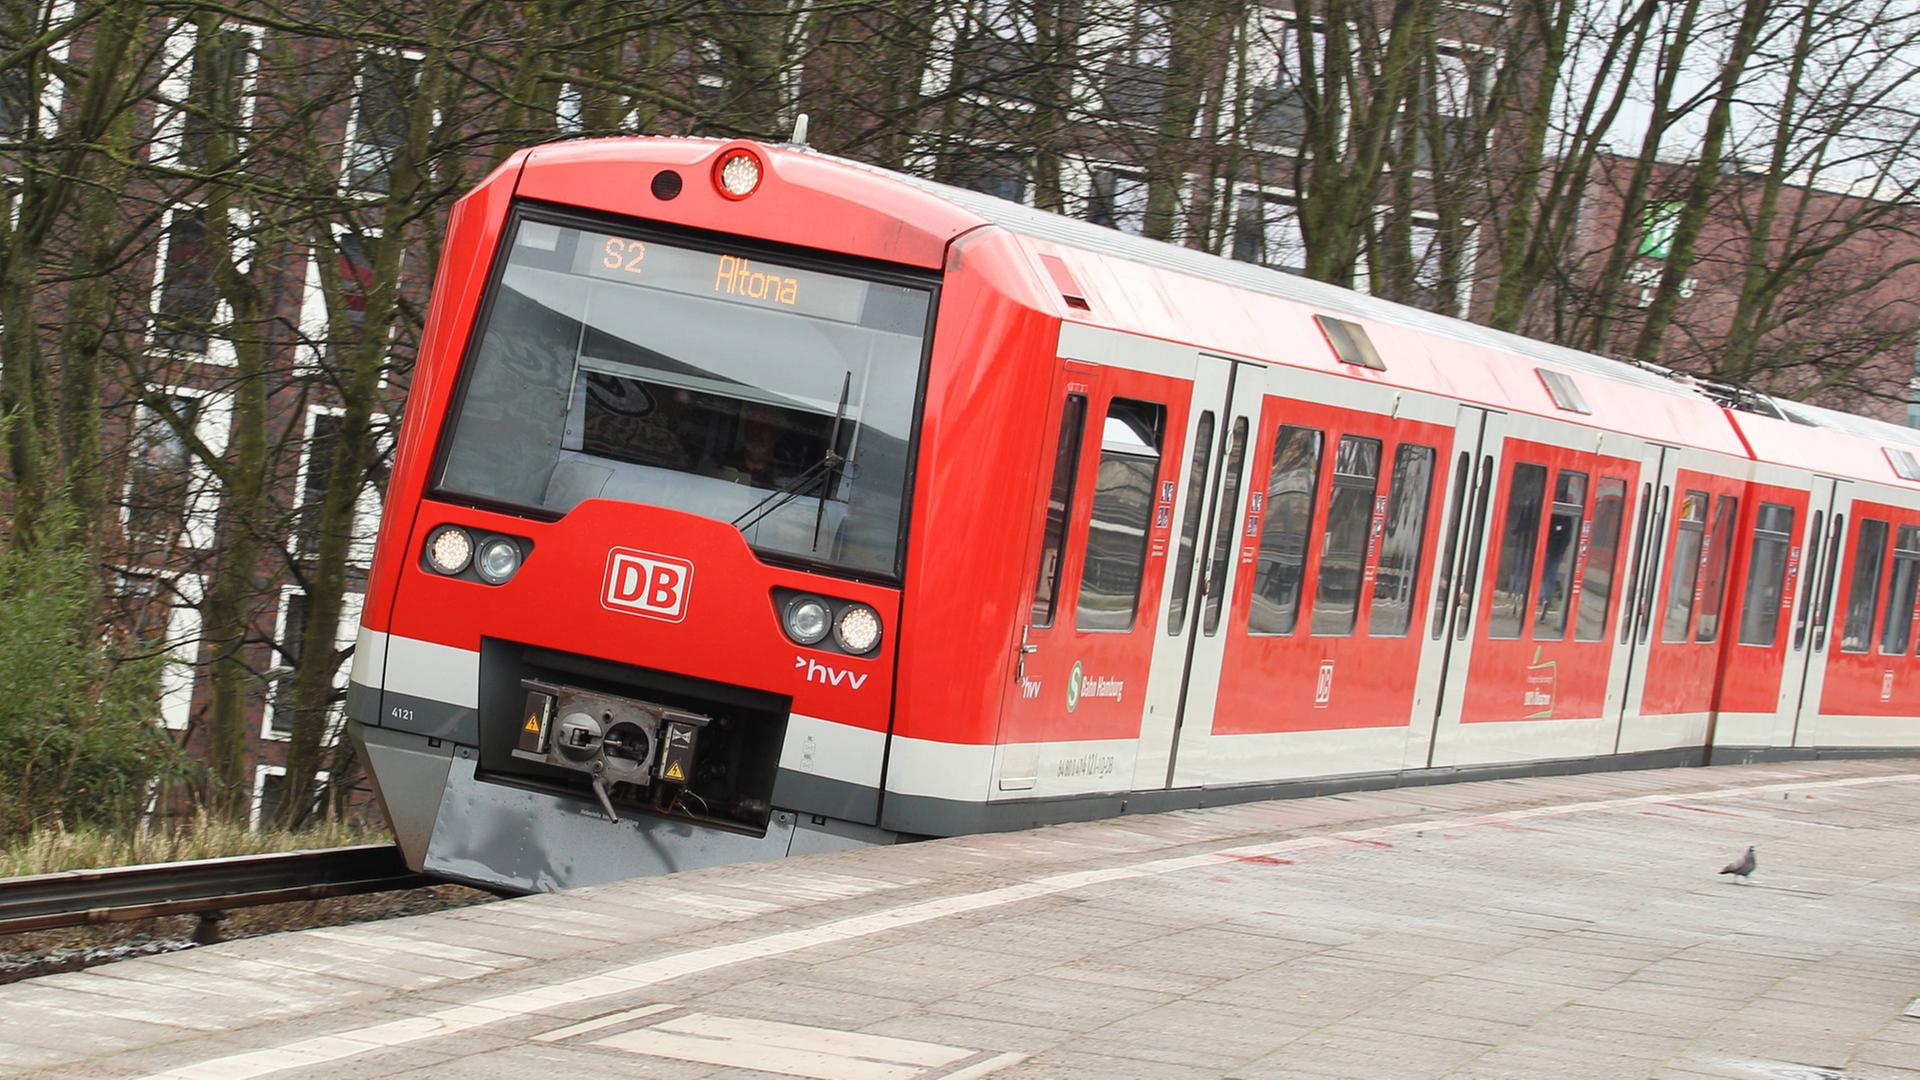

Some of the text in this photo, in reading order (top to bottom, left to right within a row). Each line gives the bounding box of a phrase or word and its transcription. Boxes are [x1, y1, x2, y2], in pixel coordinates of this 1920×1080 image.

[603, 238, 799, 305] S2 Altona
[613, 559, 680, 609] DB
[1096, 675, 1124, 702] Hamburg
[391, 707, 414, 721] 4121
